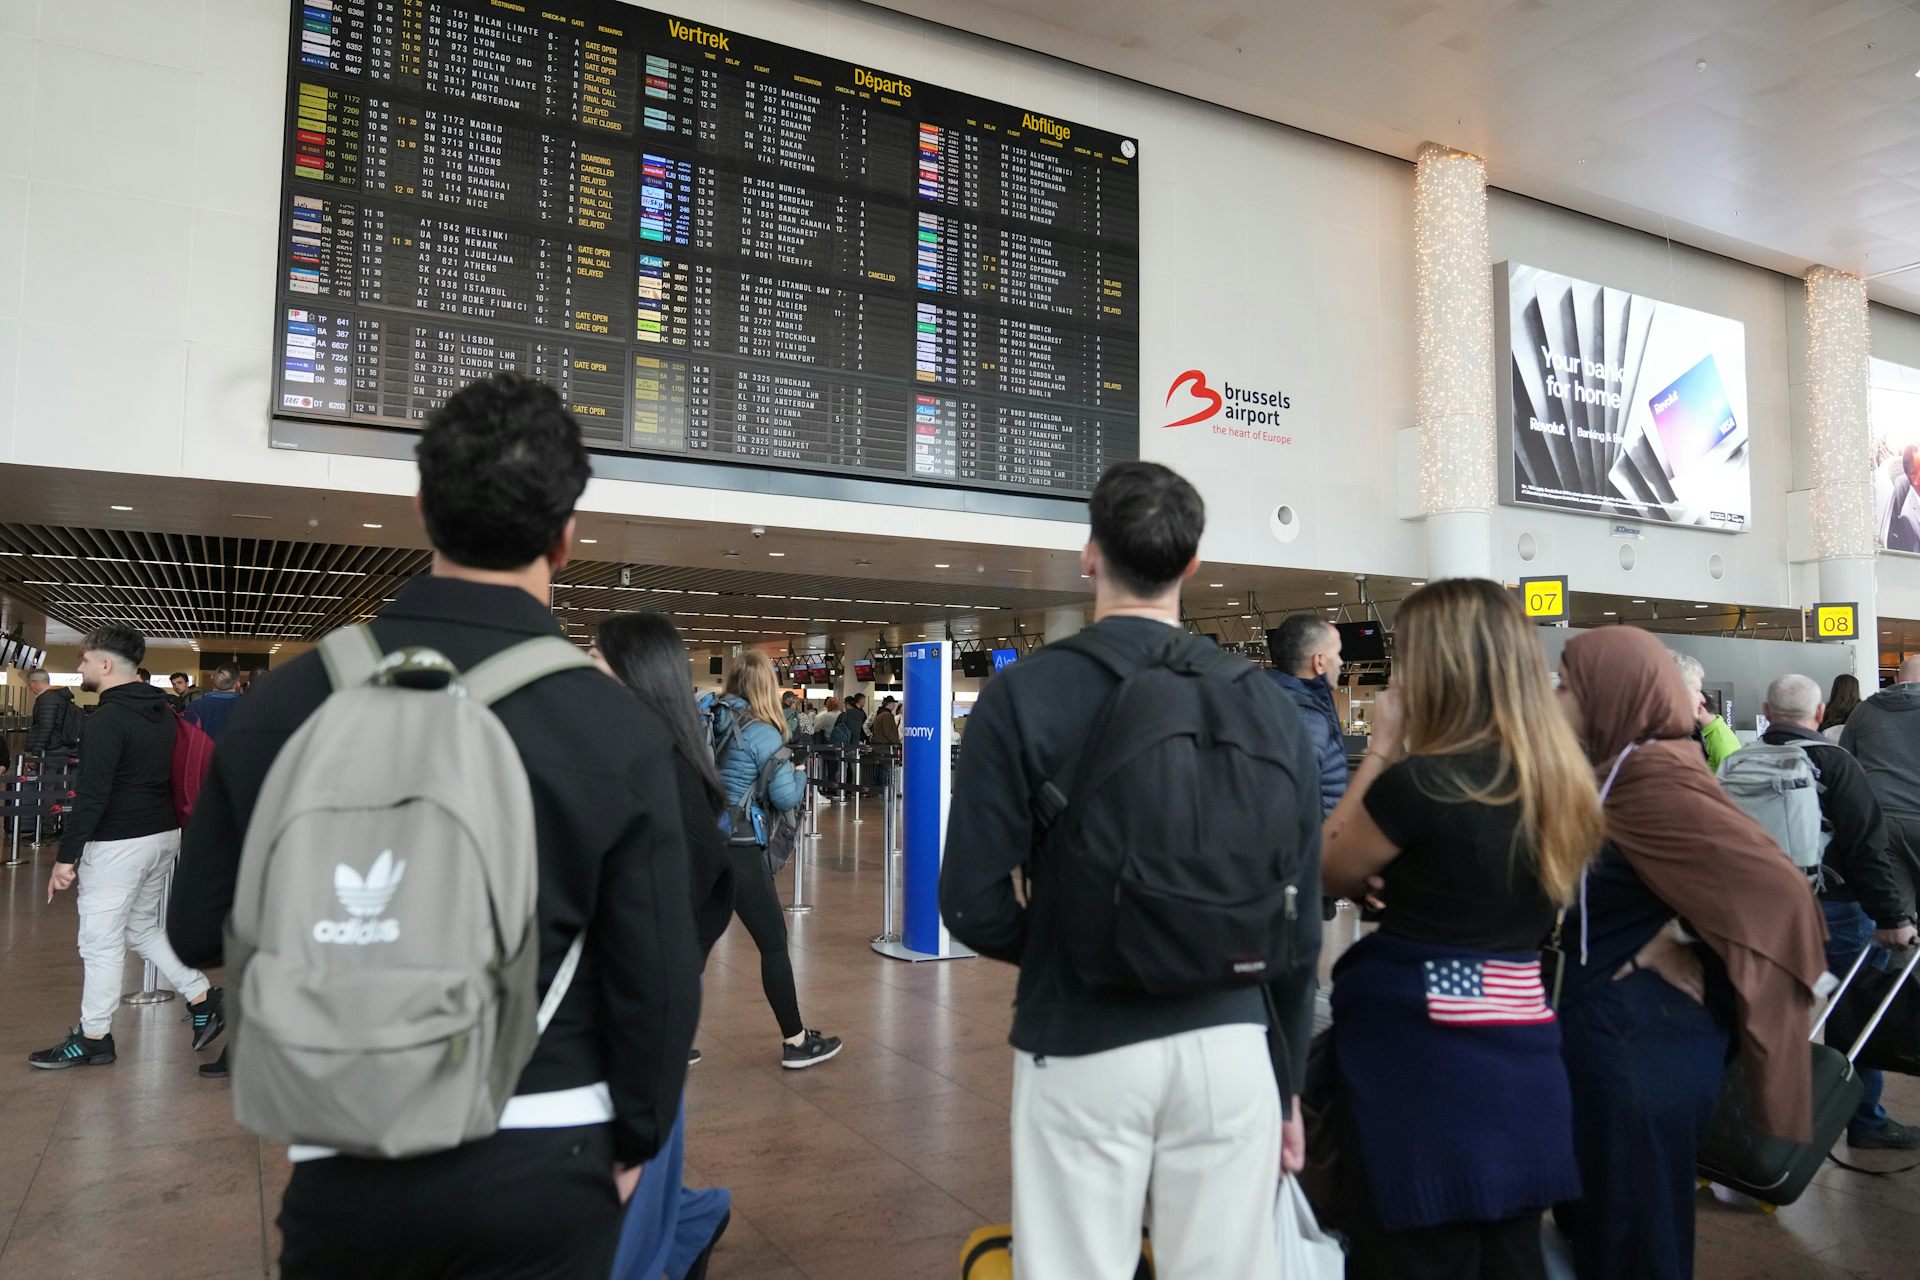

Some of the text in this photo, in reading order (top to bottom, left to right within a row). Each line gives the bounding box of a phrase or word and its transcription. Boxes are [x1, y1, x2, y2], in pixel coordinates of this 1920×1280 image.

[490, 0, 623, 36] DESTINATION CHECK-IN GATE REMARKS
[474, 25, 522, 43] MARSEILLE
[474, 14, 617, 55] MILAN LINATE GATE OPEN
[668, 19, 729, 52] Vertrek
[474, 36, 494, 48] LYON
[473, 47, 610, 85] CHICAGO ORD DELAYED
[472, 70, 536, 90] MILAN LINATE
[473, 59, 616, 97] DUBLIN FINAL CALL
[854, 68, 912, 98] Départs
[472, 80, 608, 116] PORTO DELAYED
[781, 89, 820, 104] BARCELONA
[471, 91, 621, 130] AMSTERDAM GATE CLOSED
[781, 99, 815, 113] KINSHASA
[781, 109, 811, 122] BEIJING
[470, 119, 502, 133] MADRID
[780, 119, 811, 132] CONAKRY
[1022, 113, 1071, 140] Abflüge
[781, 129, 806, 141] BANJUL
[470, 131, 610, 165] LISBON BOARDING
[780, 139, 801, 149] DAKAR
[469, 142, 614, 177] BILBAO CANCELLED
[780, 149, 814, 162] MONROVIA
[468, 153, 606, 186] ATHENS DELAYED
[780, 159, 814, 172] FREETOWN
[468, 164, 612, 198] NADOR FINAL CALL
[468, 176, 509, 190] SHANGHAI
[467, 186, 504, 200] TANGIER
[779, 183, 805, 195] MUNICH
[779, 194, 813, 207] BORDEAUX
[466, 198, 604, 229] NICE DELAYED
[779, 204, 808, 216] BANGKOK
[778, 214, 830, 230] GRAN CANARIA
[778, 224, 817, 237] BUCHAREST
[465, 238, 497, 249] NEWARK
[466, 226, 610, 257] HELSINKI GATE OPEN
[778, 244, 794, 253] NICE
[464, 260, 496, 272] ATHENS
[465, 249, 603, 278] LJUBLJANA DELAYED
[778, 254, 895, 282] TENERIFE CANCELLED
[464, 272, 485, 282] OSLO
[464, 283, 506, 296] ISTANBUL
[778, 279, 811, 291] ISTANBUL
[463, 294, 526, 310] ROME FIUMICI
[777, 290, 802, 300] MUNICH
[462, 306, 495, 317] BEIRUT
[776, 300, 806, 311] ALGIERS
[776, 310, 802, 320] ATHENS
[776, 320, 802, 330] MADRID
[461, 334, 493, 345] LISBON
[776, 331, 815, 342] STOCKHOLM
[461, 345, 514, 359] LONDON LHR
[776, 341, 806, 351] VILNIUS
[461, 357, 514, 370] LONDON LHR
[775, 351, 814, 363] FRANKFURT
[1541, 346, 1624, 382] Your bank
[775, 387, 801, 396] LONDON
[1225, 382, 1290, 409] brussels
[1546, 375, 1622, 408] for home
[775, 397, 814, 408] AMSTERDAM
[1654, 390, 1678, 415] Revolut
[774, 408, 800, 417] VIENNA
[1226, 403, 1280, 426] airport
[774, 418, 791, 426] DOHA
[774, 428, 794, 437] DUBAI
[1213, 425, 1291, 445] the heart of Europe
[1530, 417, 1566, 436] Revolut
[1577, 427, 1604, 443] Banking
[774, 438, 808, 449] BUDAPEST
[773, 449, 800, 458] GENEVA
[1531, 594, 1557, 610] 07
[1824, 617, 1848, 631] 08
[313, 918, 400, 945] adidas
